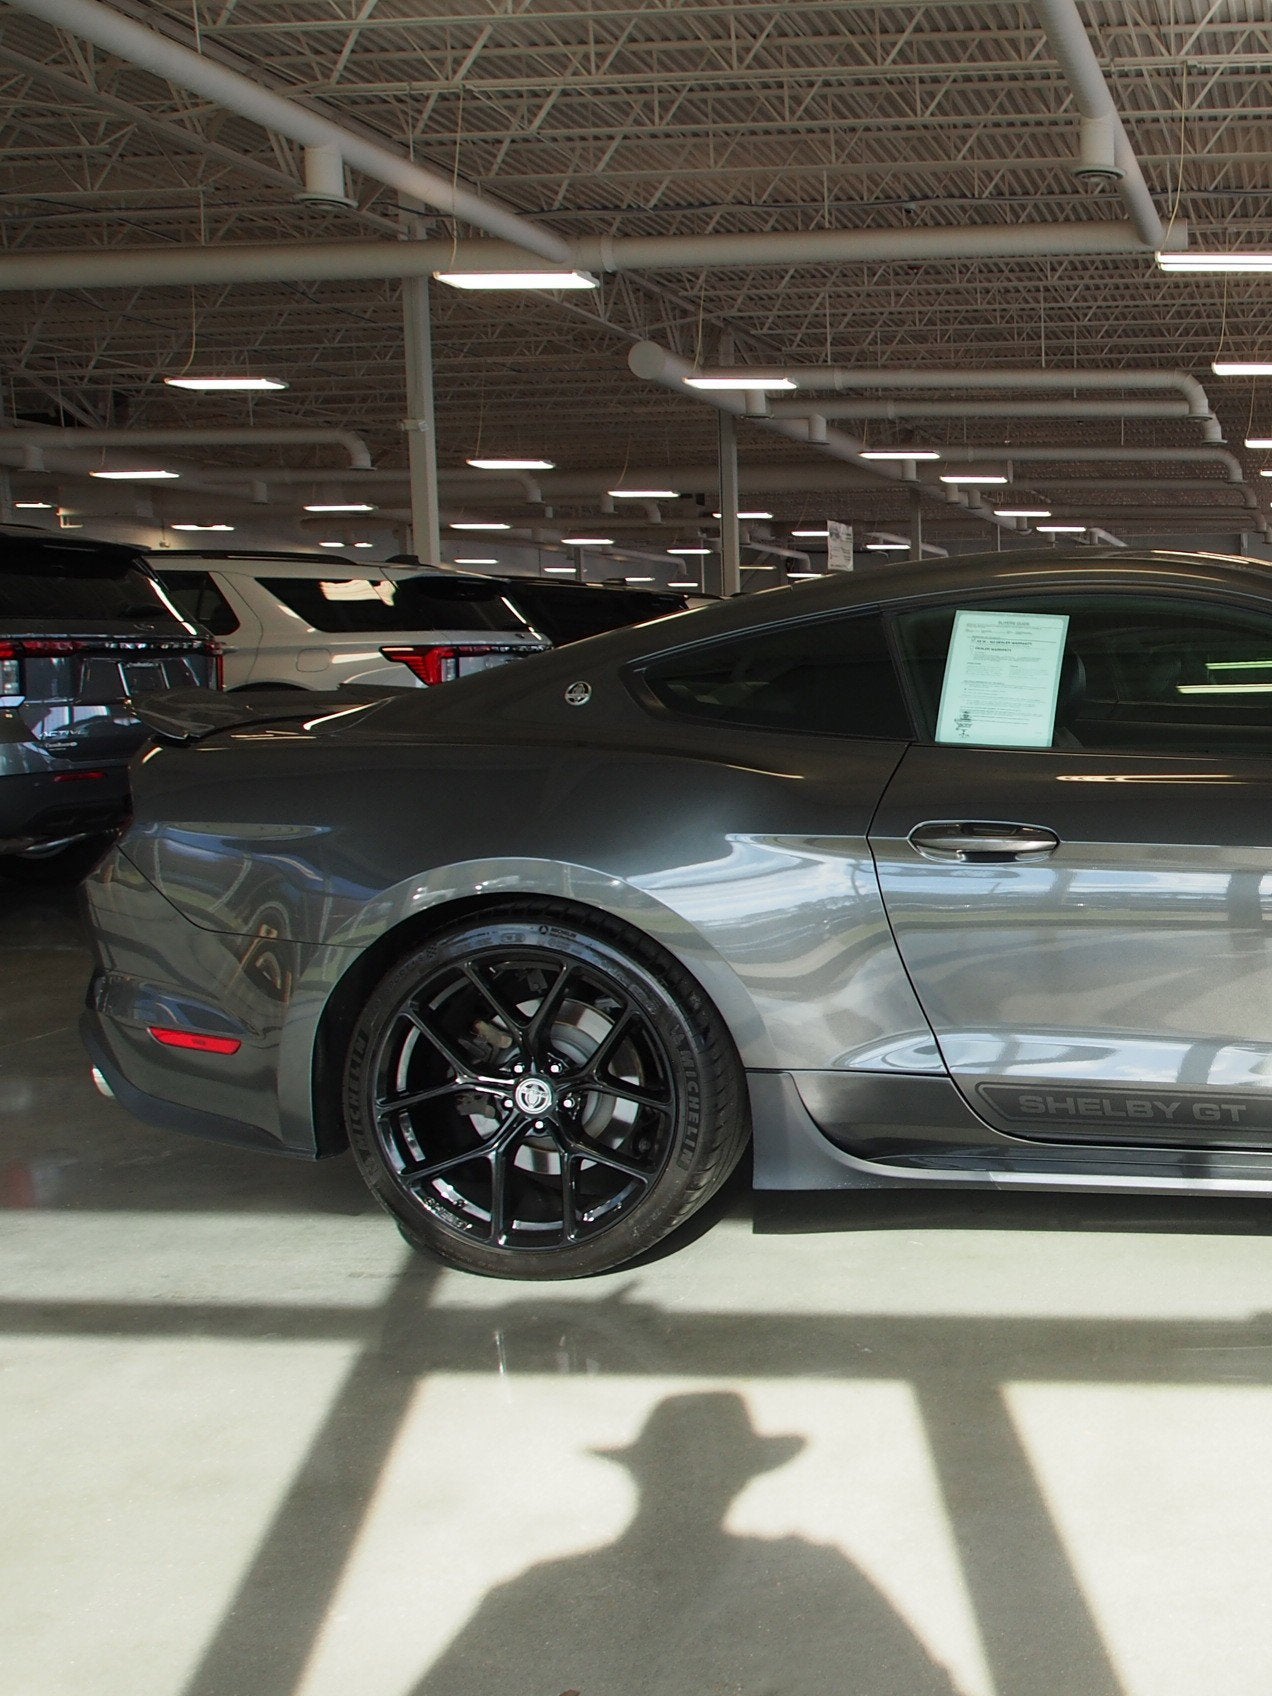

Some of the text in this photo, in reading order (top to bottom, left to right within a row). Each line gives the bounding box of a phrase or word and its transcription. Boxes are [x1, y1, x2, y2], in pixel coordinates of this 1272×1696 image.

[680, 1050, 701, 1165] MICHELIN
[1018, 1094, 1247, 1122] SHELBY GT
